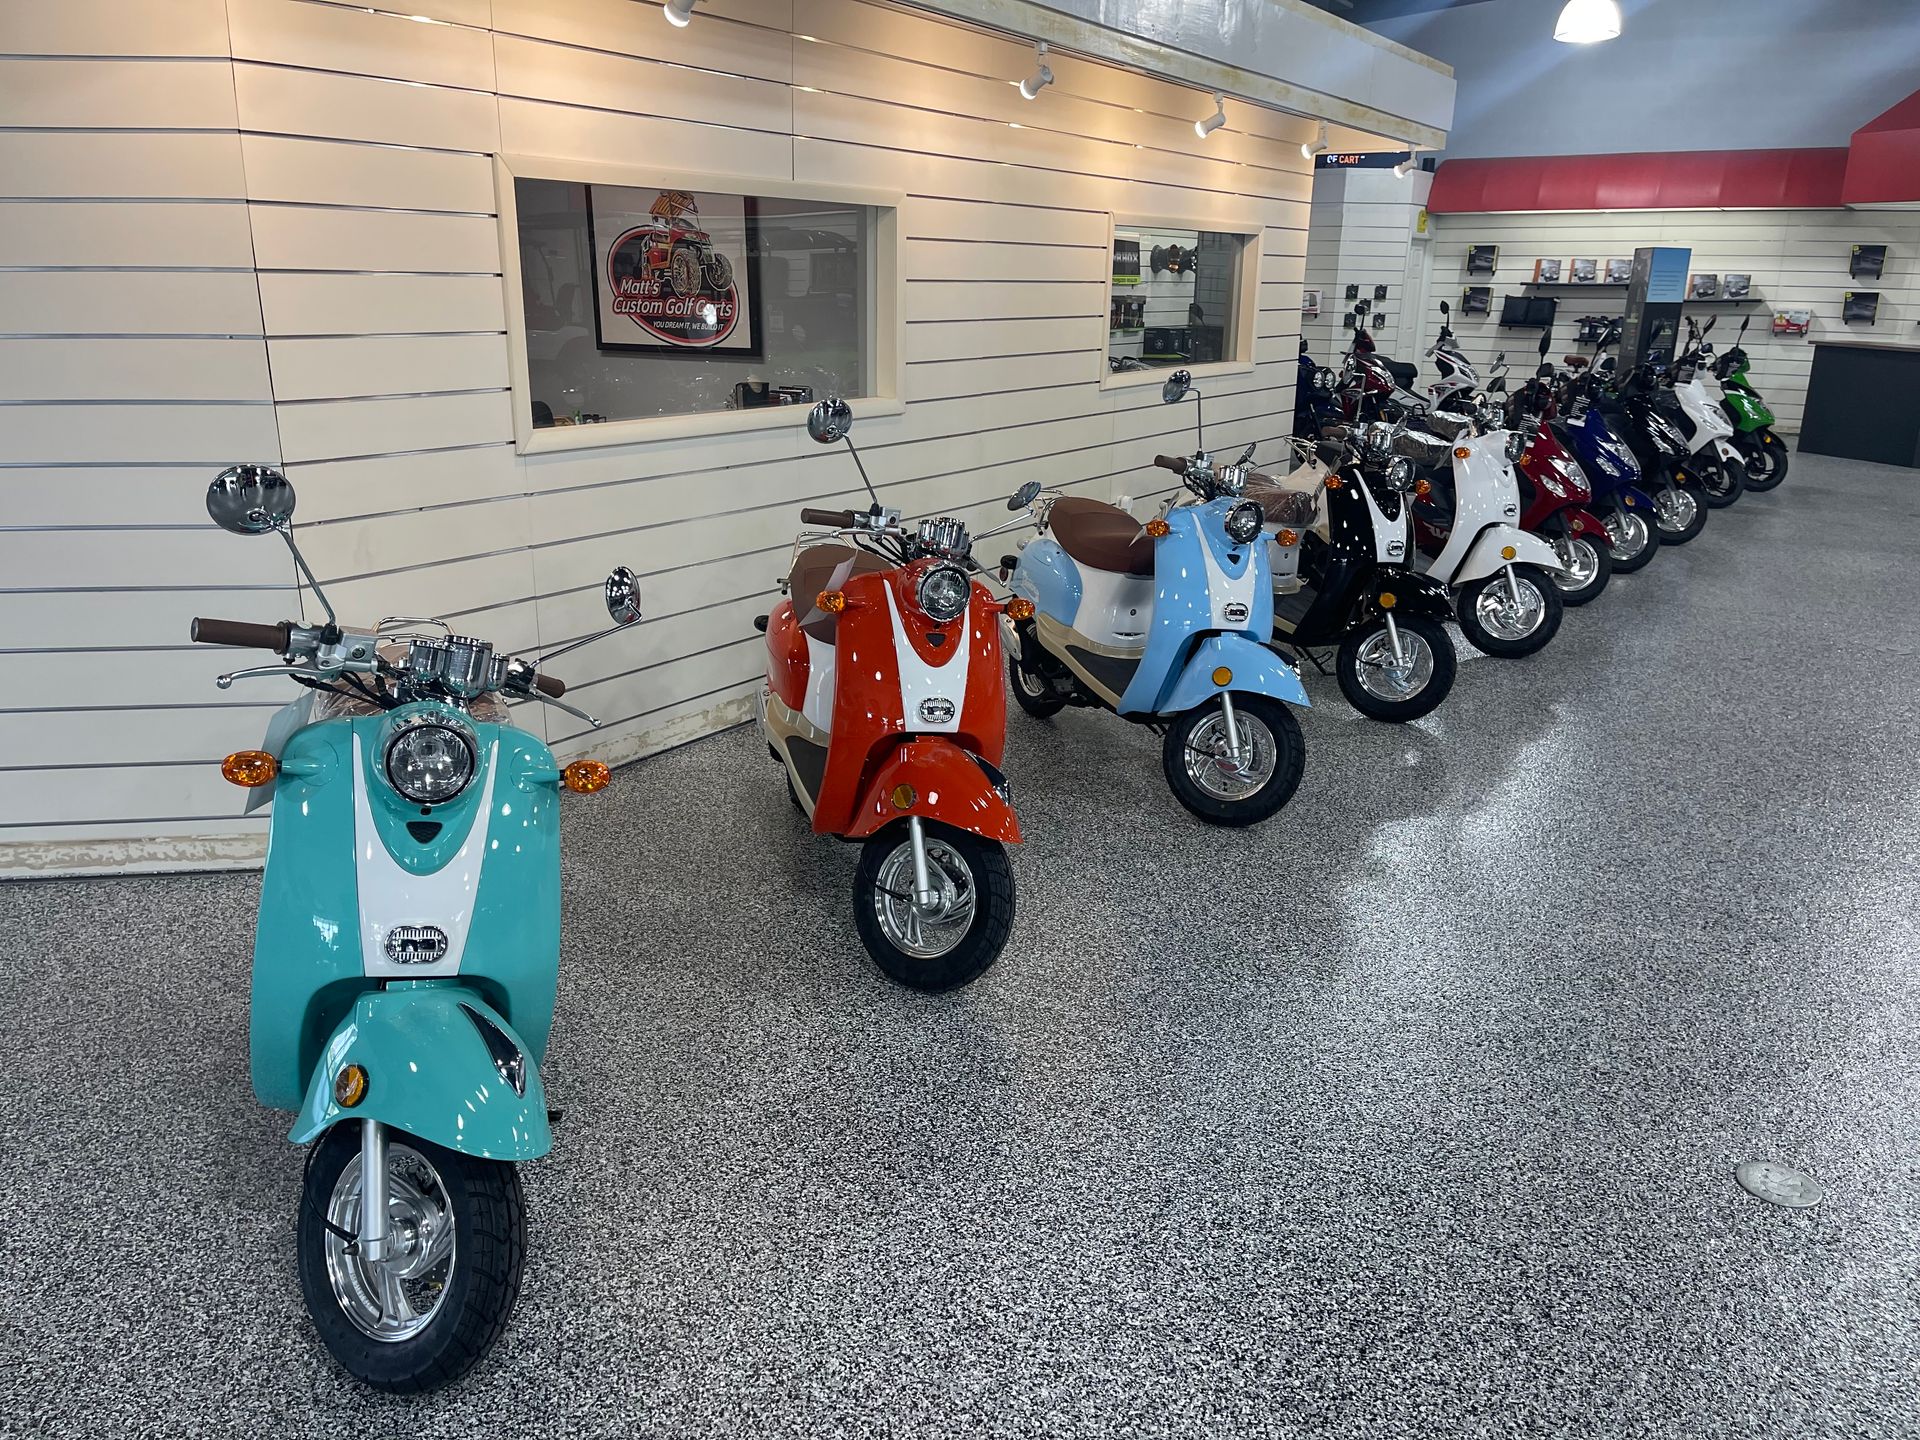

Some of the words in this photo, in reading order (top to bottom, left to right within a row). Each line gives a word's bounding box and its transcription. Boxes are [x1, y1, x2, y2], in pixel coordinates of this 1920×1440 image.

[1339, 155, 1360, 164] CART
[620, 278, 660, 294] Matt's
[613, 297, 662, 314] Custom
[666, 298, 694, 315] Golf
[696, 299, 733, 317] Crts
[665, 321, 684, 329] DREAM
